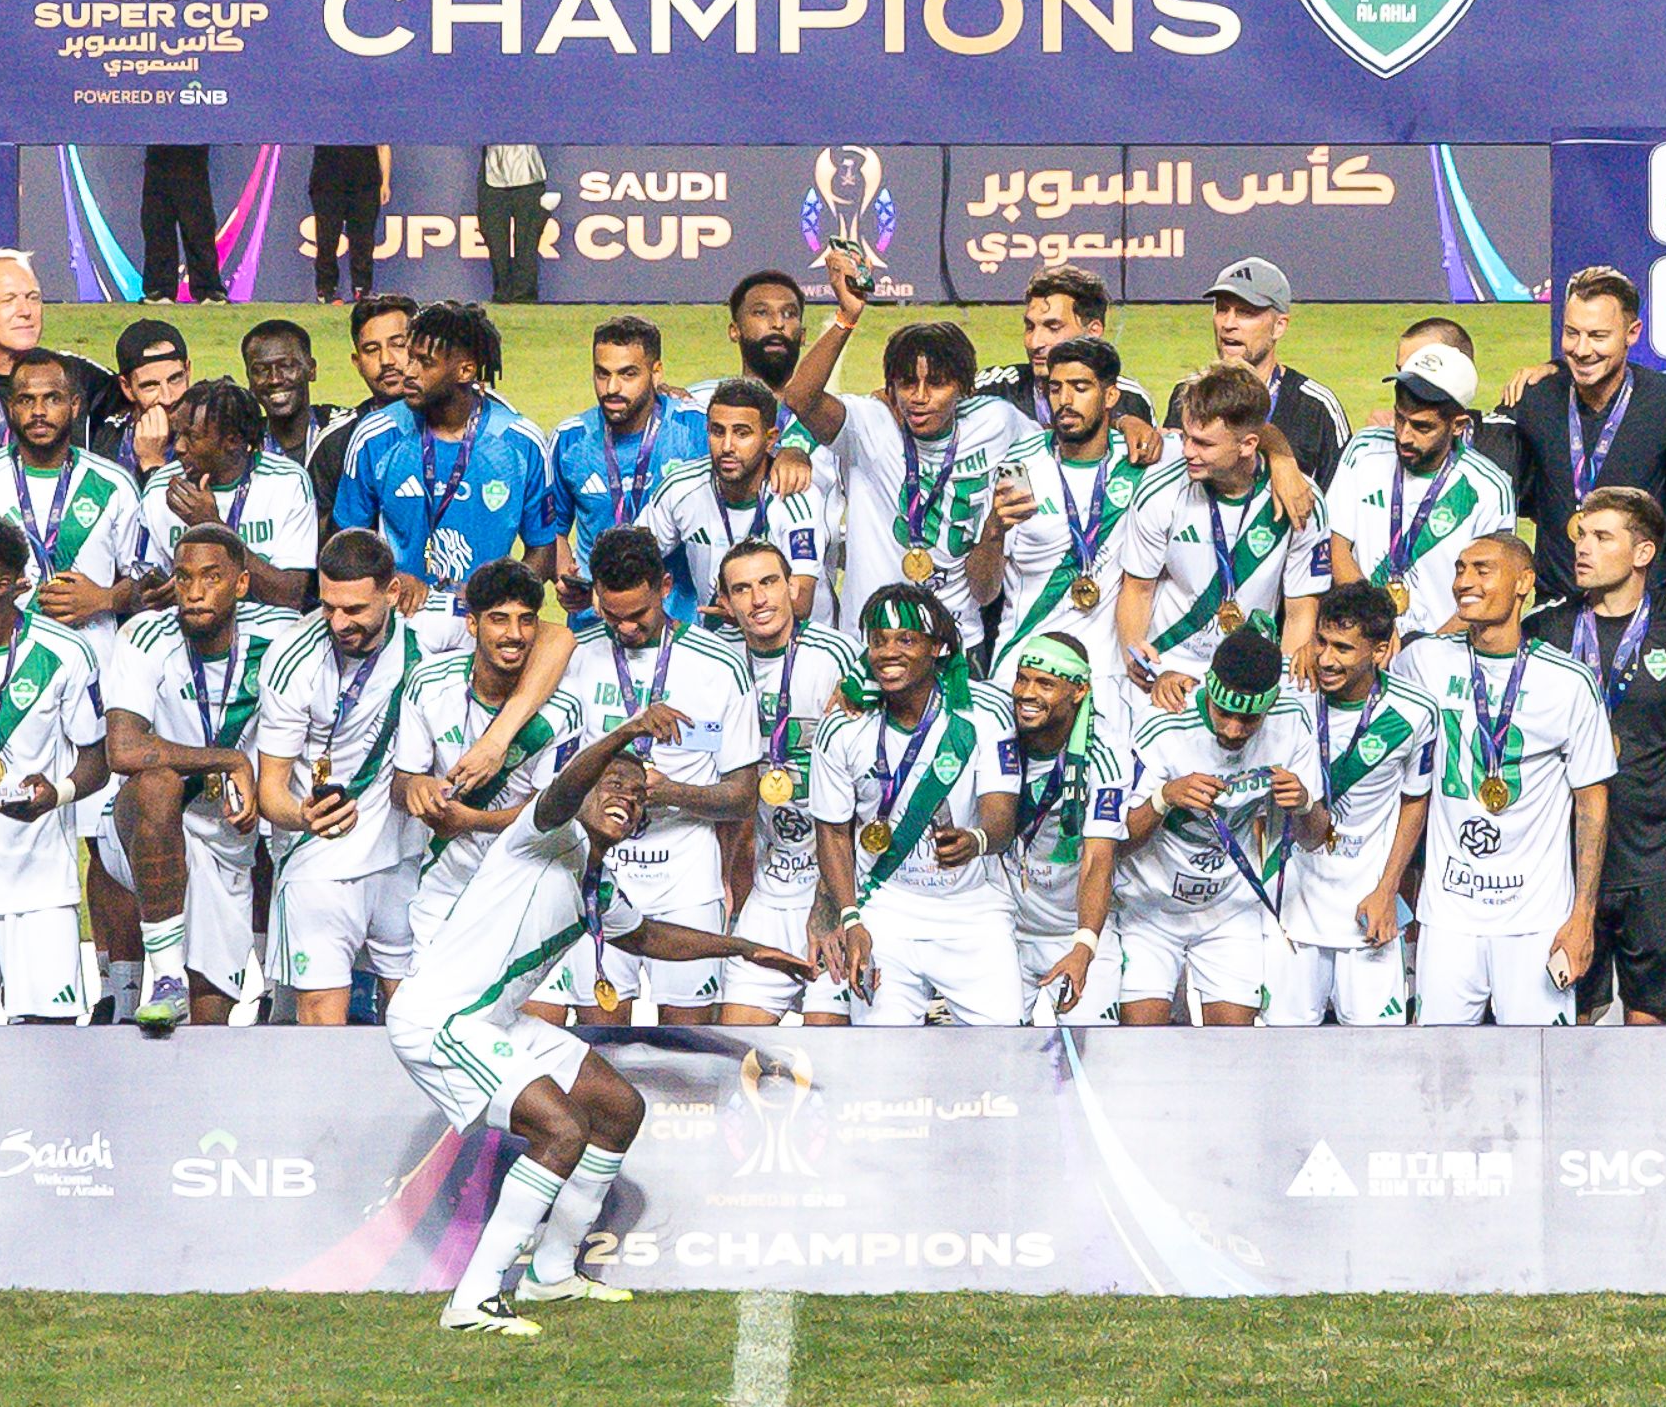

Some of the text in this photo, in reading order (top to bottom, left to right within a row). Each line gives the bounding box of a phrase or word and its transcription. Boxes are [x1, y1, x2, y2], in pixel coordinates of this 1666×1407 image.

[33, 2, 269, 28] SUPER CUP
[1356, 4, 1417, 22] AL AHLI
[58, 26, 245, 59] كأس السوبر
[103, 57, 199, 78] السعودي
[74, 89, 228, 106] POWERED BY SNB
[578, 170, 728, 203] SAUDI
[965, 145, 1396, 223] كأس السوبر
[573, 214, 733, 260] CUP
[965, 227, 1185, 275] السعودي
[873, 283, 914, 297] SNB
[1440, 709, 1524, 810] 10
[652, 1102, 715, 1116] SAUDI
[835, 1092, 1019, 1122] كأس السوبر
[651, 1120, 717, 1140] CUP
[835, 1125, 930, 1145] السعودي
[33, 1172, 94, 1186] Welcome
[171, 1156, 317, 1198] SNB
[1559, 1150, 1666, 1188] SMC
[56, 1185, 115, 1197] to Arabia
[706, 1194, 847, 1208] POWERED BY SNB
[583, 1231, 1056, 1268] 25 CHAMPIONS
